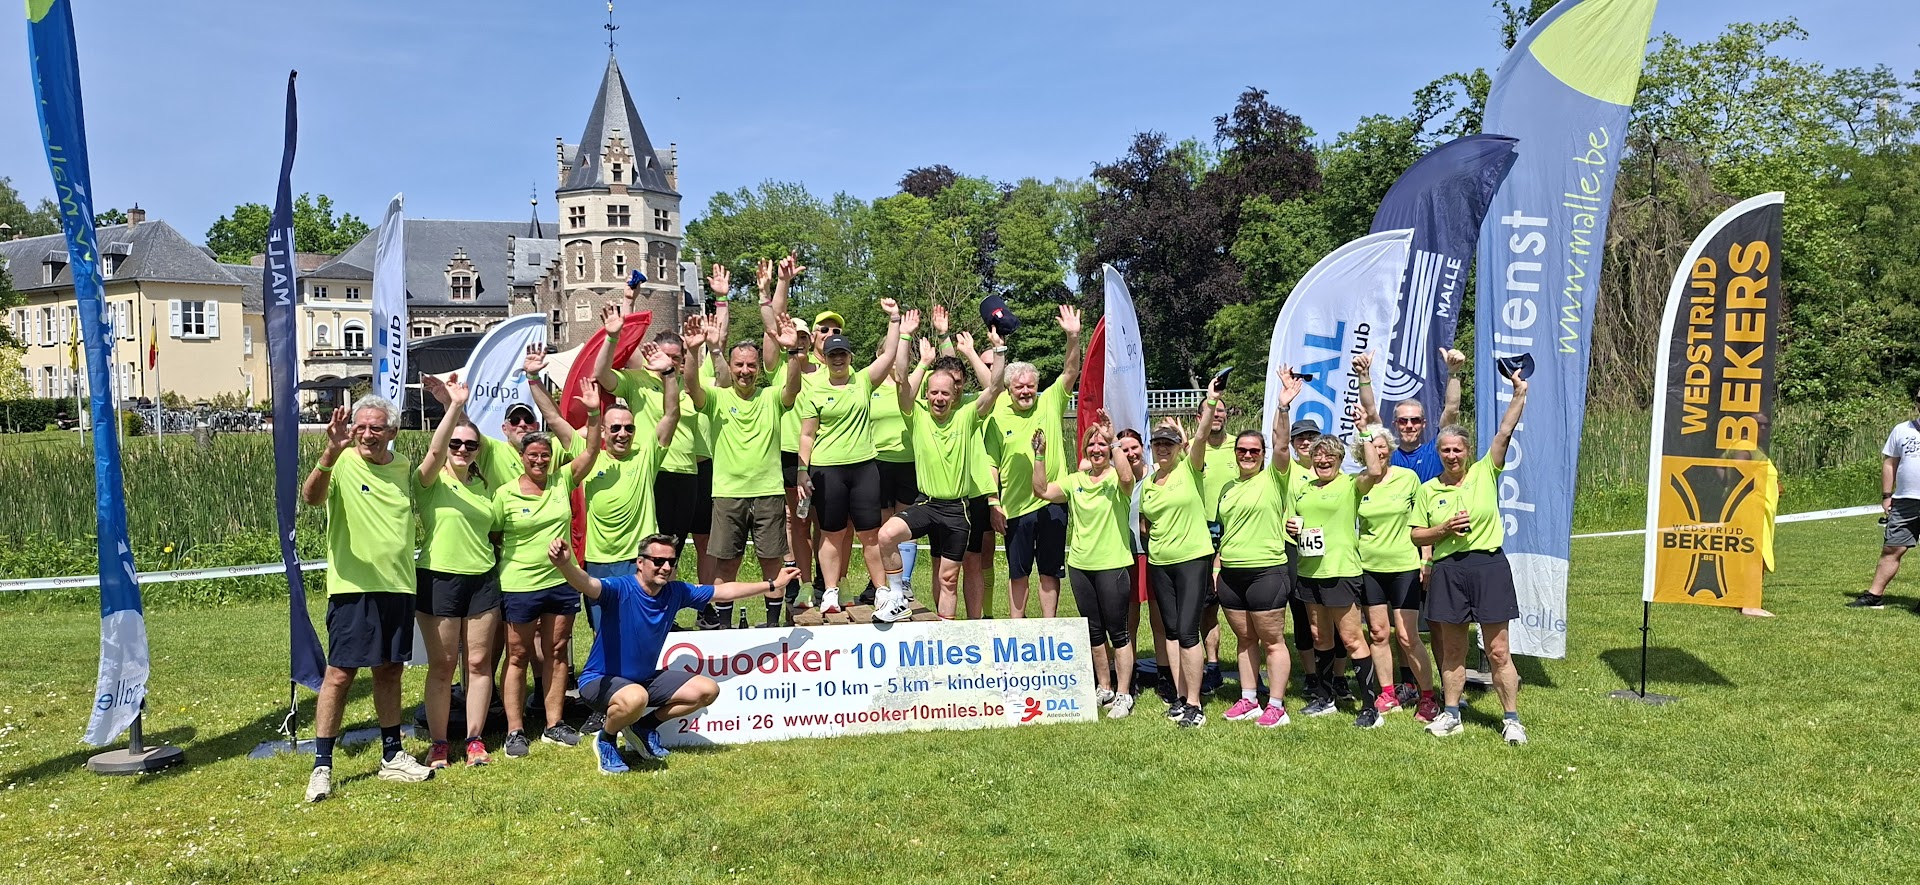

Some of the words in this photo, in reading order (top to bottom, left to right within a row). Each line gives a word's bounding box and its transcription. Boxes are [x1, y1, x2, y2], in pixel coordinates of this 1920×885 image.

[1558, 126, 1609, 354] www.malle.be
[1436, 256, 1462, 318] MALLE
[1681, 256, 1717, 434] WEDSTRIJD
[1715, 240, 1770, 450] BEKERS
[1295, 320, 1346, 435] DAL
[1338, 321, 1371, 446] Atletieklub
[1491, 210, 1549, 537] spotienst
[475, 381, 519, 403] pidpa
[1663, 532, 1755, 554] BEKERS
[1672, 523, 1744, 535] WEDSTRIJD
[53, 577, 86, 586] Quooker
[170, 570, 203, 579] Quooker
[228, 565, 261, 574] Quooker
[662, 642, 841, 678] Quooker
[850, 641, 887, 669] 10
[899, 639, 982, 668] Miles
[992, 636, 1074, 663] Malle
[736, 684, 758, 701] 10
[763, 681, 796, 703] mijl
[816, 680, 837, 697] 10
[842, 679, 869, 696] km
[887, 677, 898, 694] 5
[903, 675, 929, 693] km
[947, 670, 1078, 692] kinderjoggings
[678, 717, 700, 734] 24
[706, 715, 740, 733] mei
[783, 701, 1005, 728] www.quooker10miles.be
[1046, 698, 1080, 711] DAL
